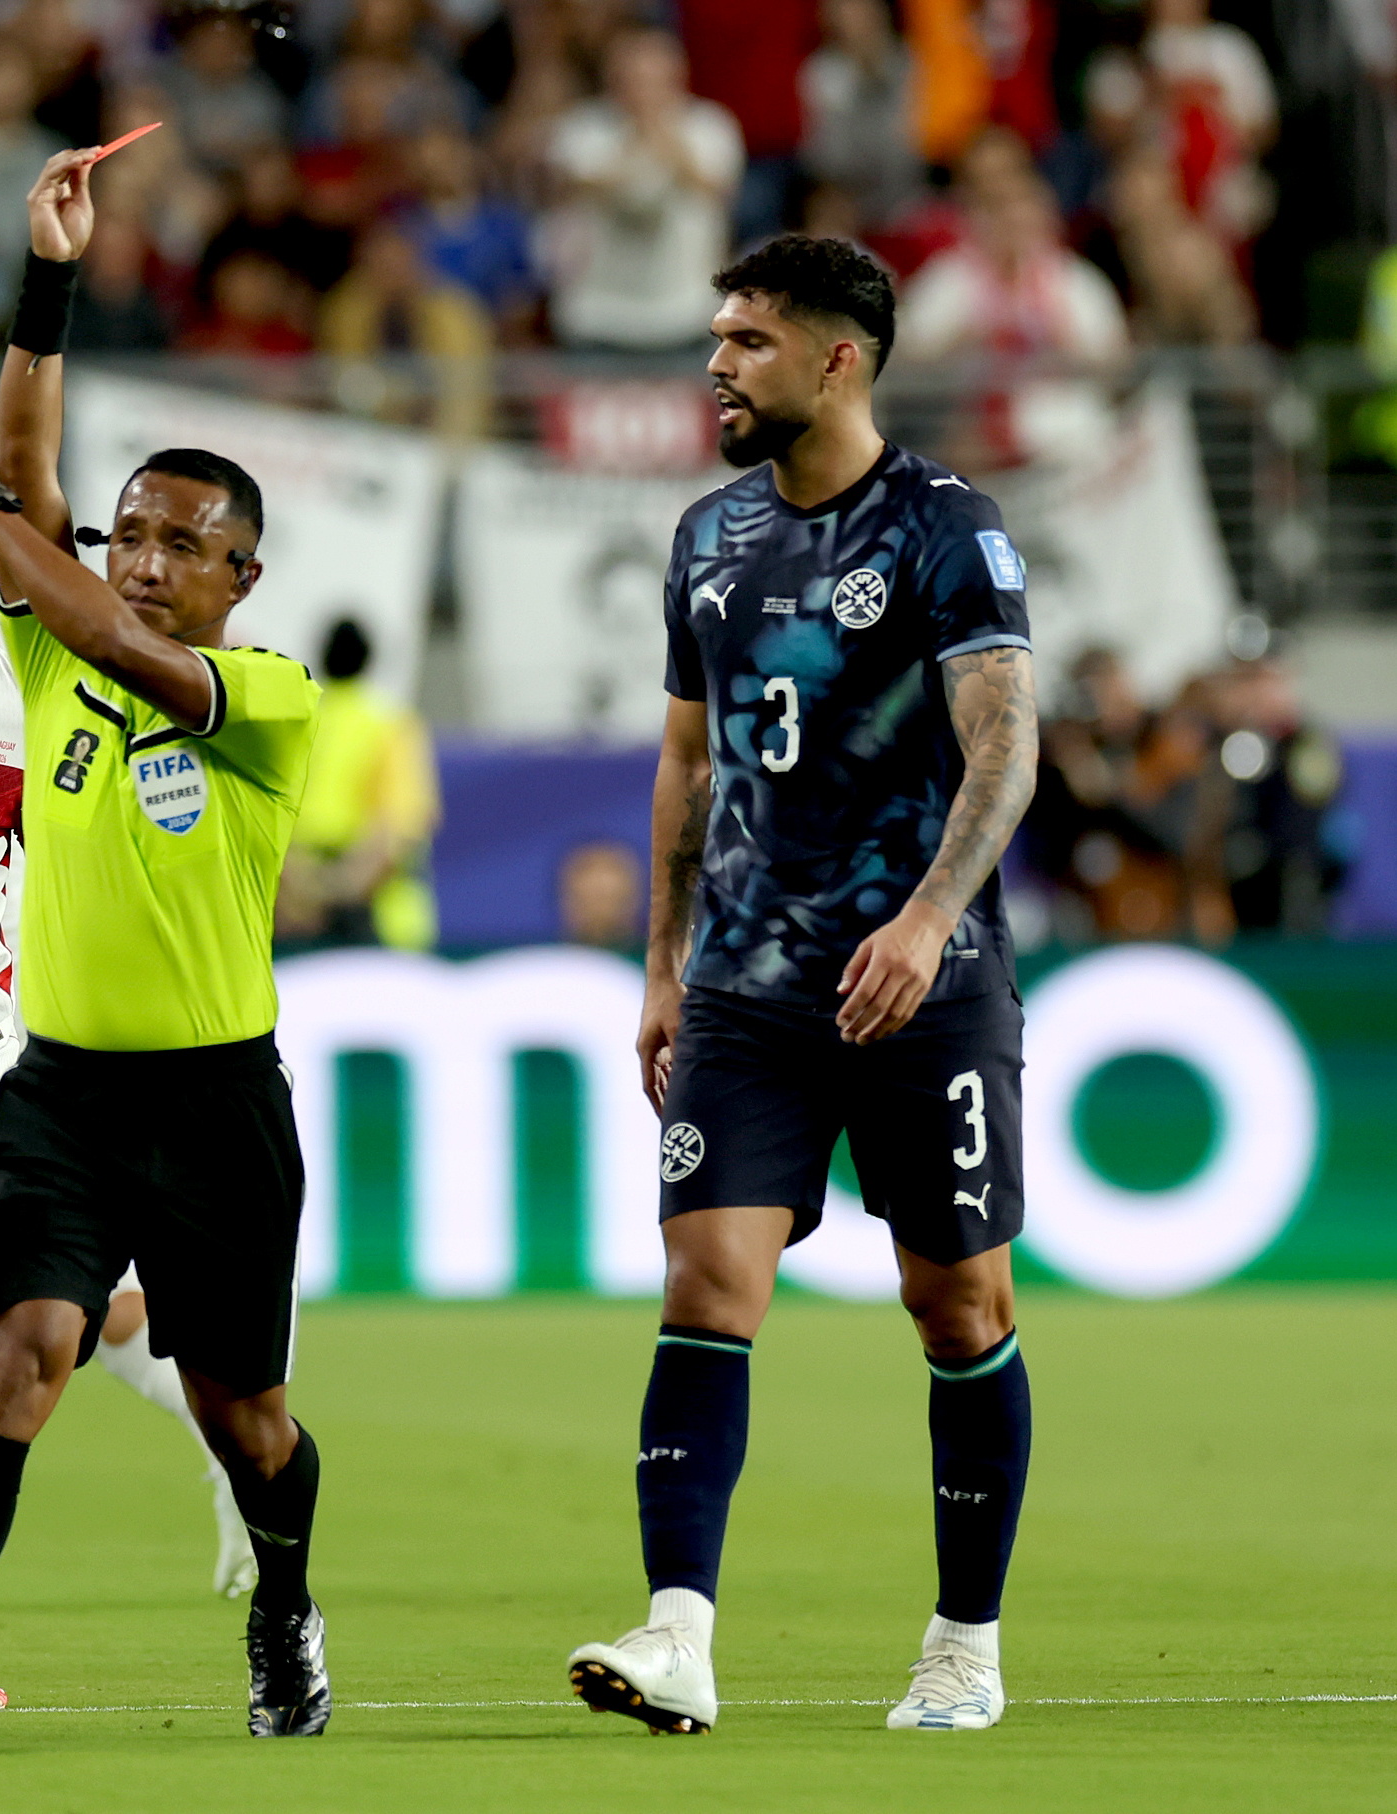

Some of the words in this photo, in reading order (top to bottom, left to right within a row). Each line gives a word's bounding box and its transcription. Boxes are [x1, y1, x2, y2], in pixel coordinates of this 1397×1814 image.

[761, 677, 800, 772] 3
[139, 753, 195, 783] FIFA
[145, 784, 201, 807] REFEREE
[946, 1068, 988, 1171] 3
[635, 1447, 688, 1466] APF
[938, 1485, 989, 1504] APF
